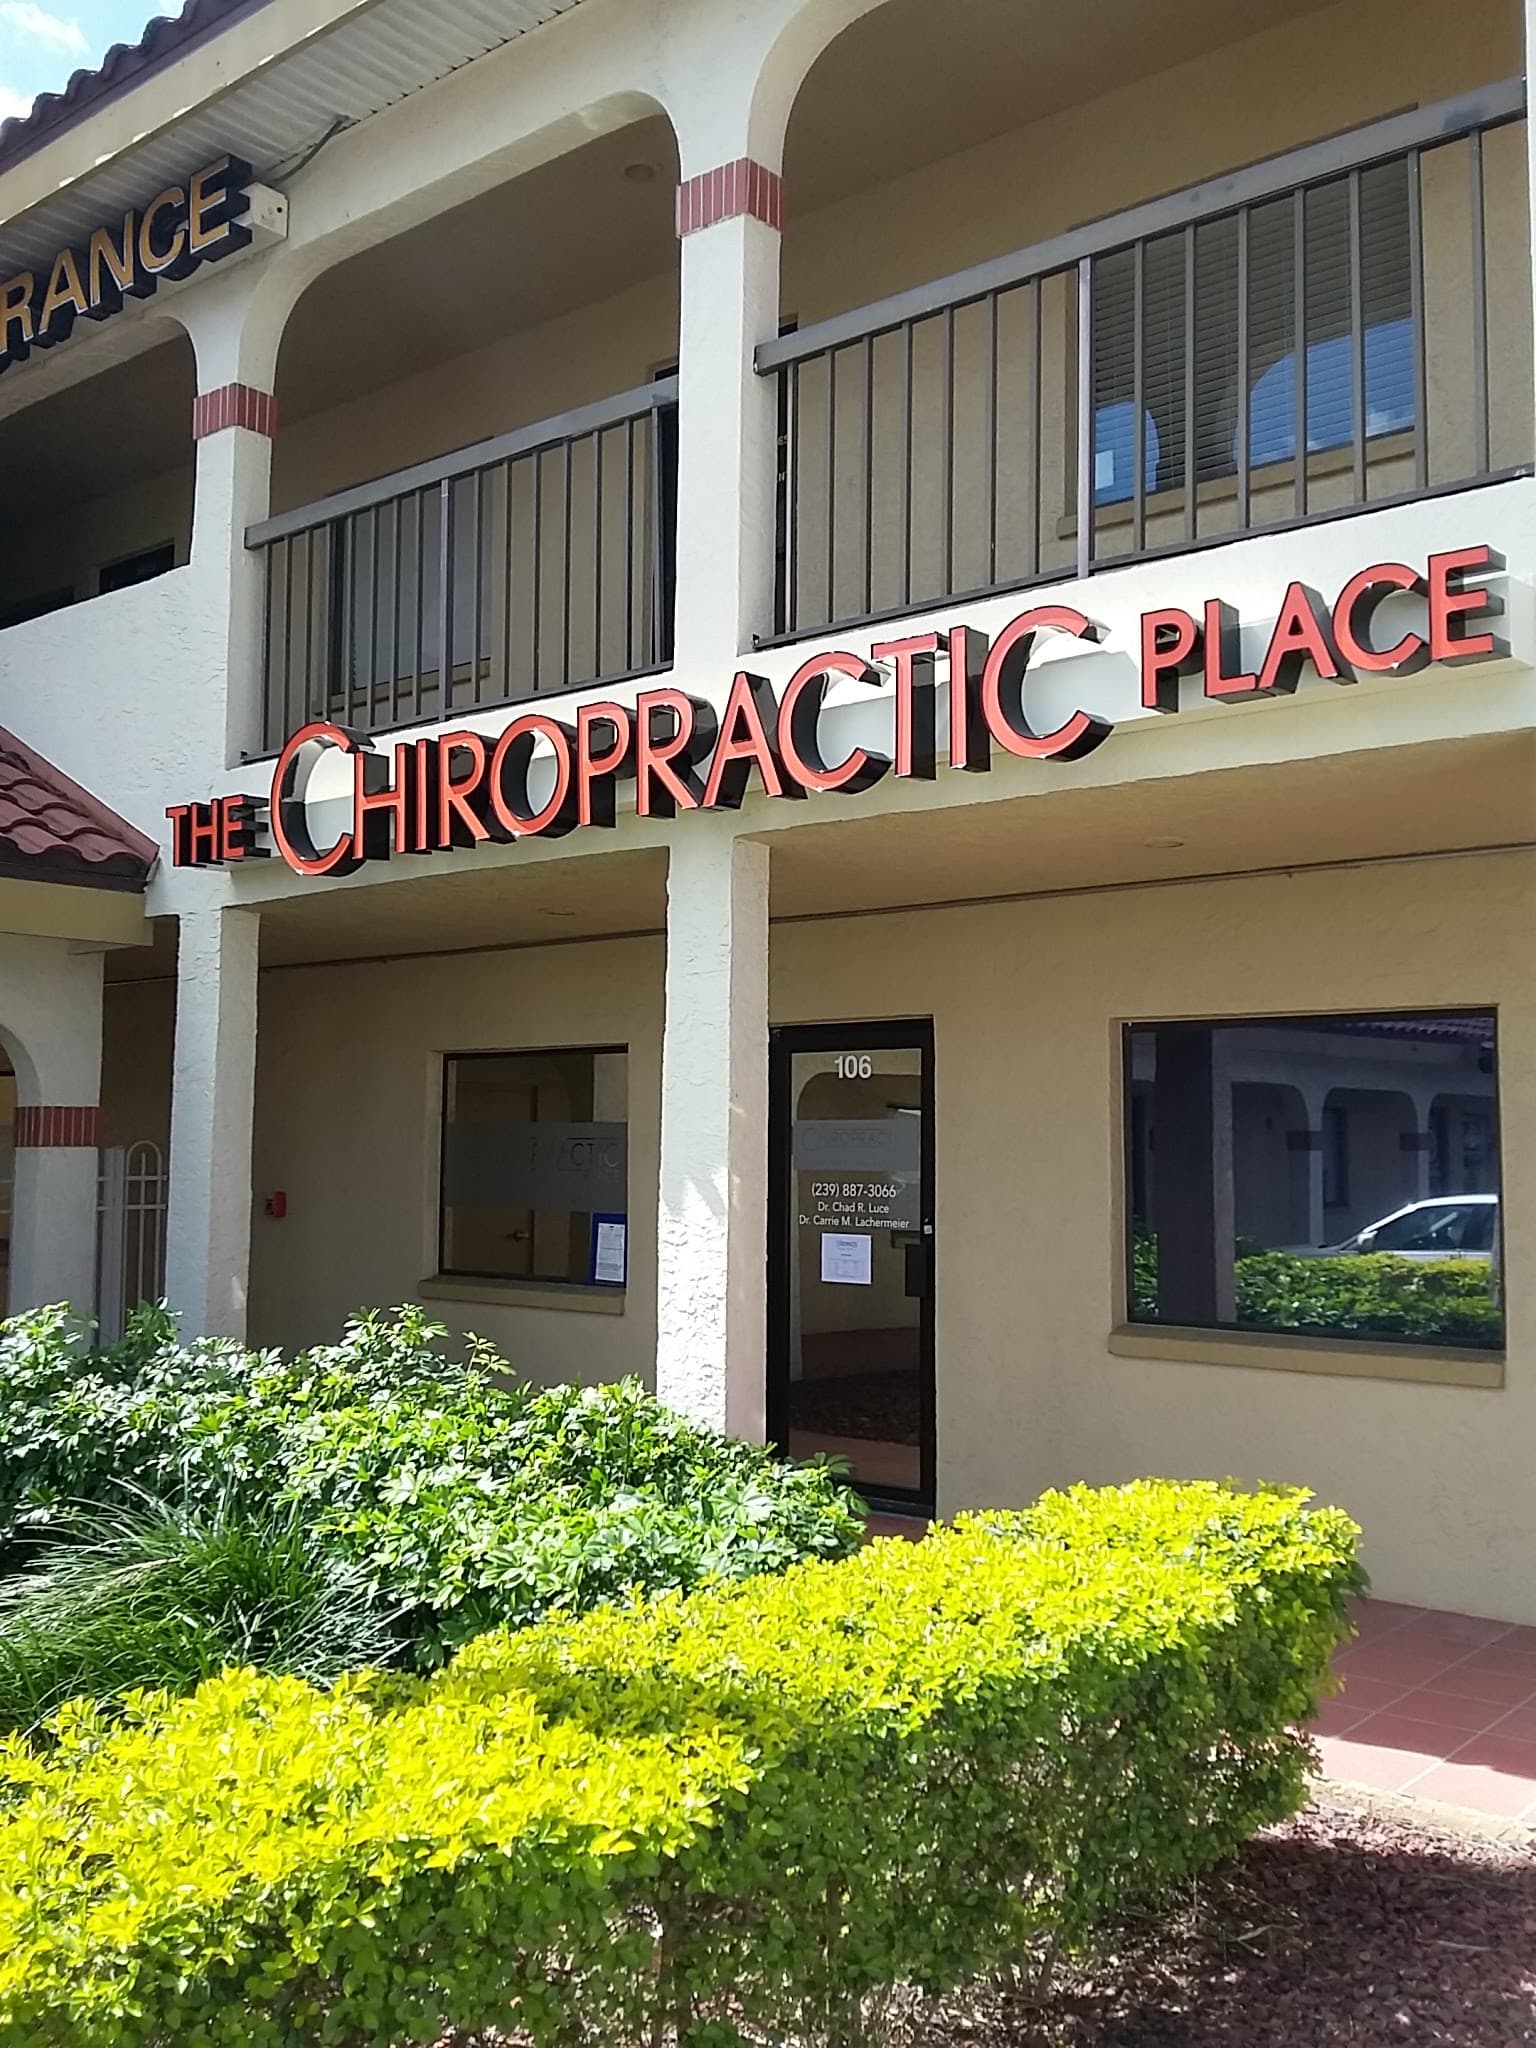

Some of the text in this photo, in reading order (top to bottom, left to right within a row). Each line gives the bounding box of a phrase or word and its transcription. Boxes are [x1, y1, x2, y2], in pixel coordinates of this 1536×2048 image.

[0, 155, 236, 354] RANCE
[165, 544, 1500, 876] THE CHIROPRACTIC PLACE
[834, 1055, 872, 1080] 106
[811, 1182, 897, 1199] (239) 887-3066
[818, 1201, 890, 1214] Dr. Chad R. Luce
[799, 1214, 910, 1229] Dr. Carrie M. Lachermeier
